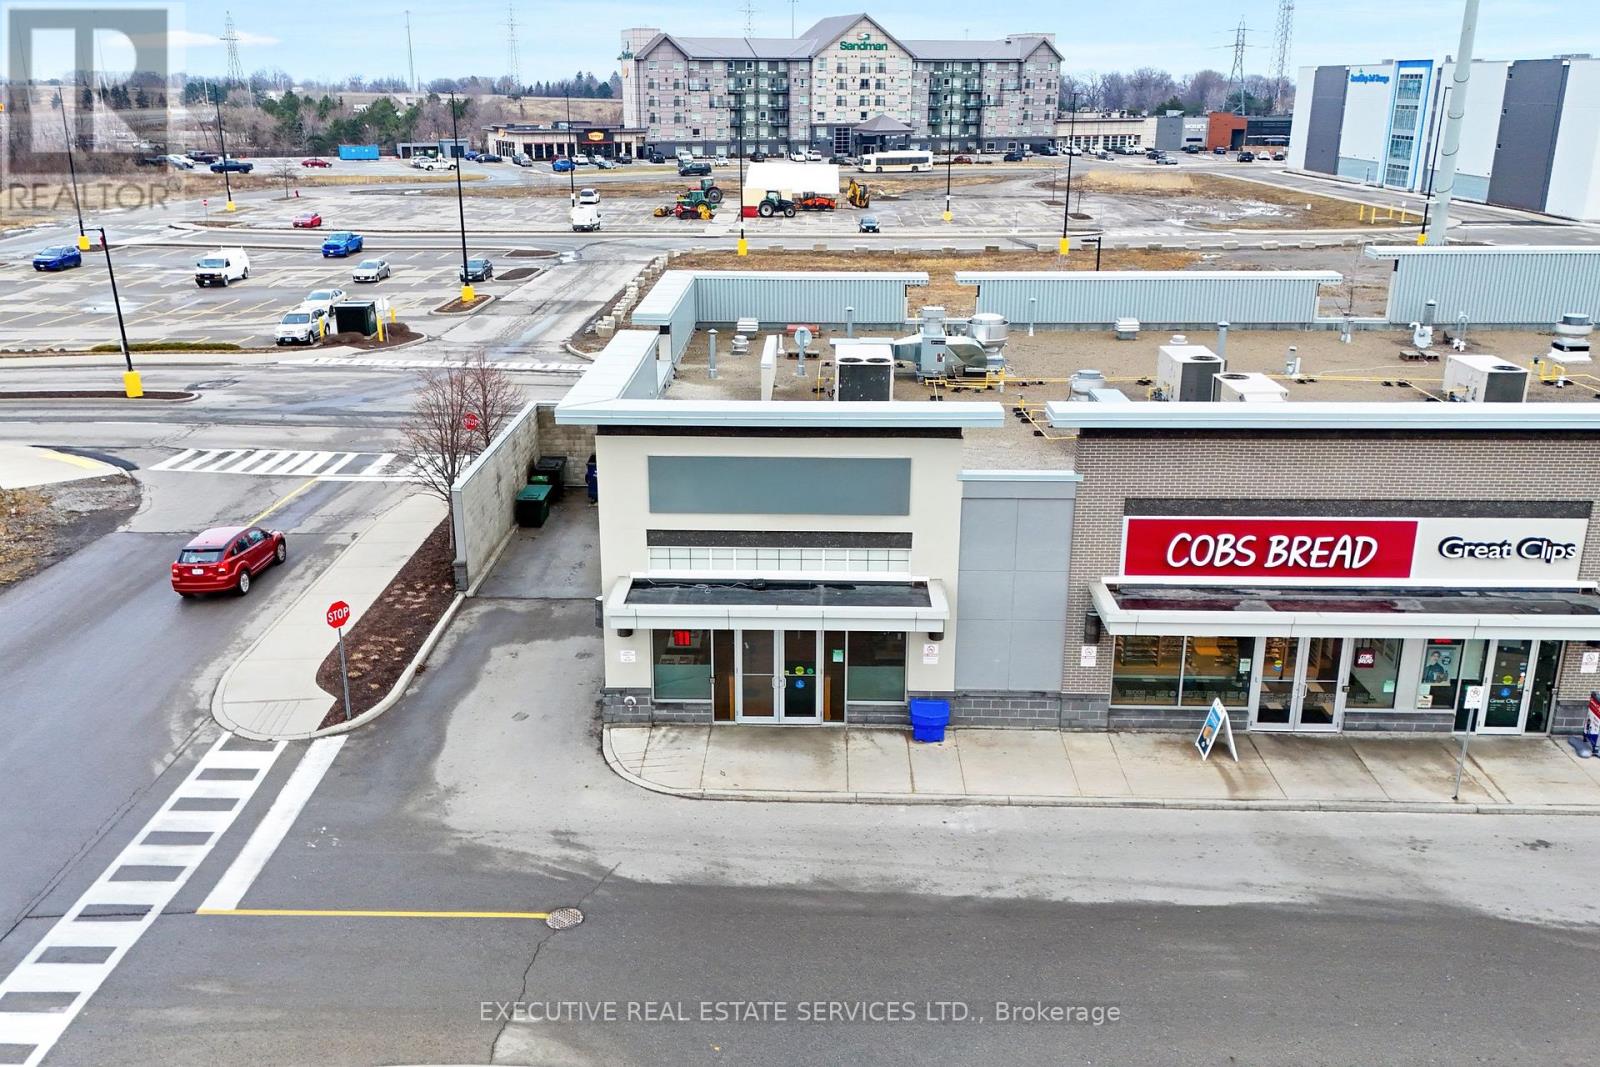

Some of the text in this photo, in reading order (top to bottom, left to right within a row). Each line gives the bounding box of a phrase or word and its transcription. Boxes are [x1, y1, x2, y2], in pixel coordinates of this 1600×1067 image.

[839, 41, 888, 51] Sandman
[1166, 532, 1379, 569] COBS BREAD
[1438, 536, 1577, 564] Great Clips
[328, 606, 349, 623] STOP
